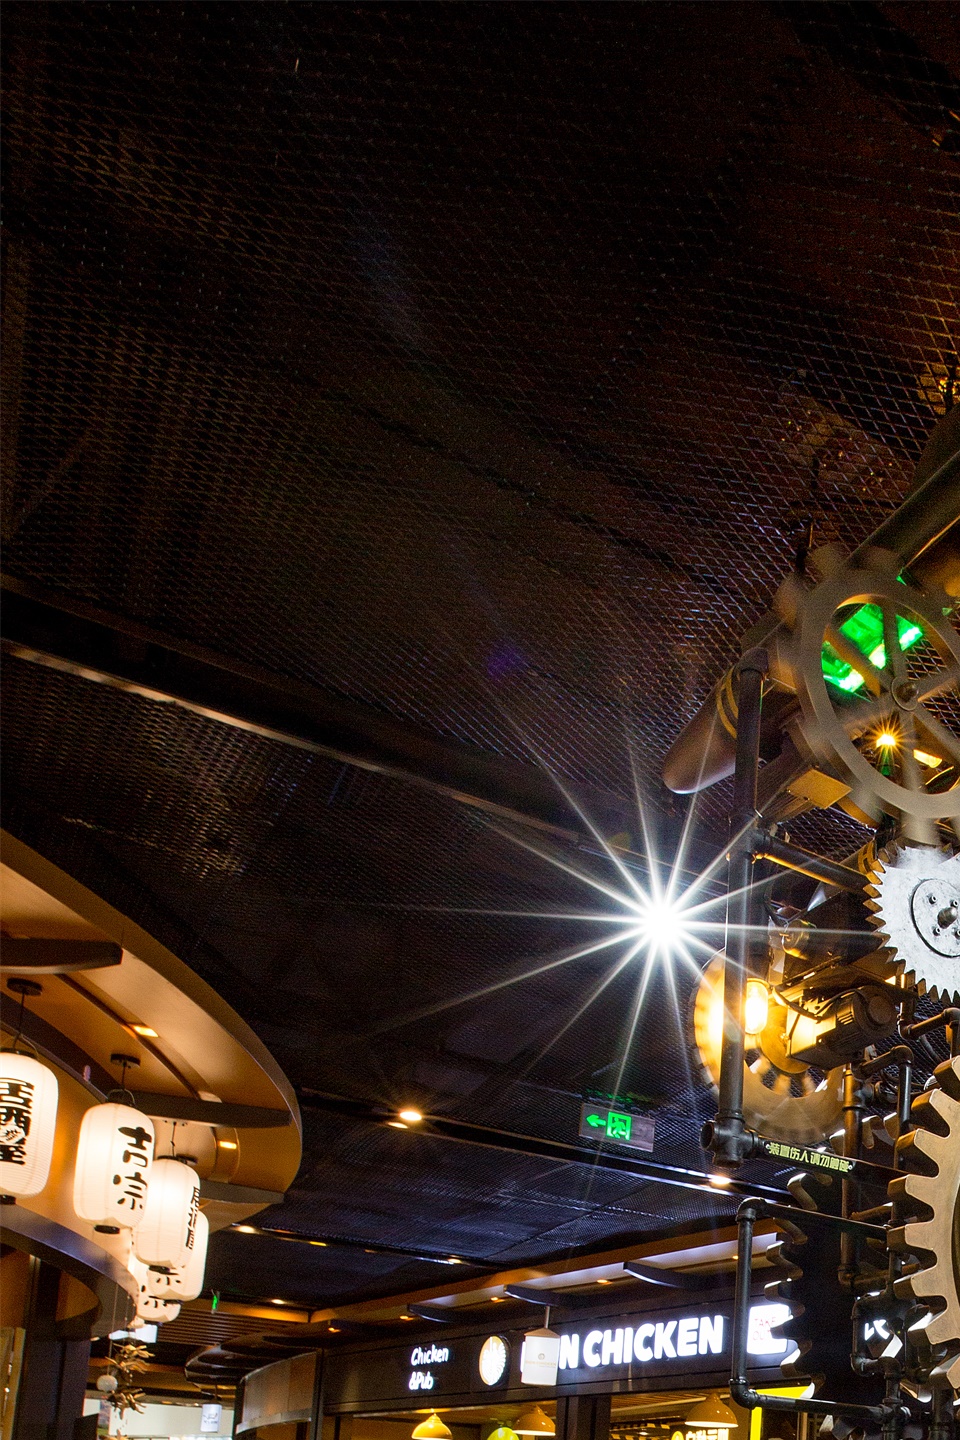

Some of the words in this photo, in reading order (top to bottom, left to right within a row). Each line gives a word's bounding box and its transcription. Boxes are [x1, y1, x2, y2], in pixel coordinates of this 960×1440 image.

[583, 1314, 724, 1368] CHICKEN
[410, 1344, 449, 1367] Chicken
[408, 1371, 434, 1391] &Pub
